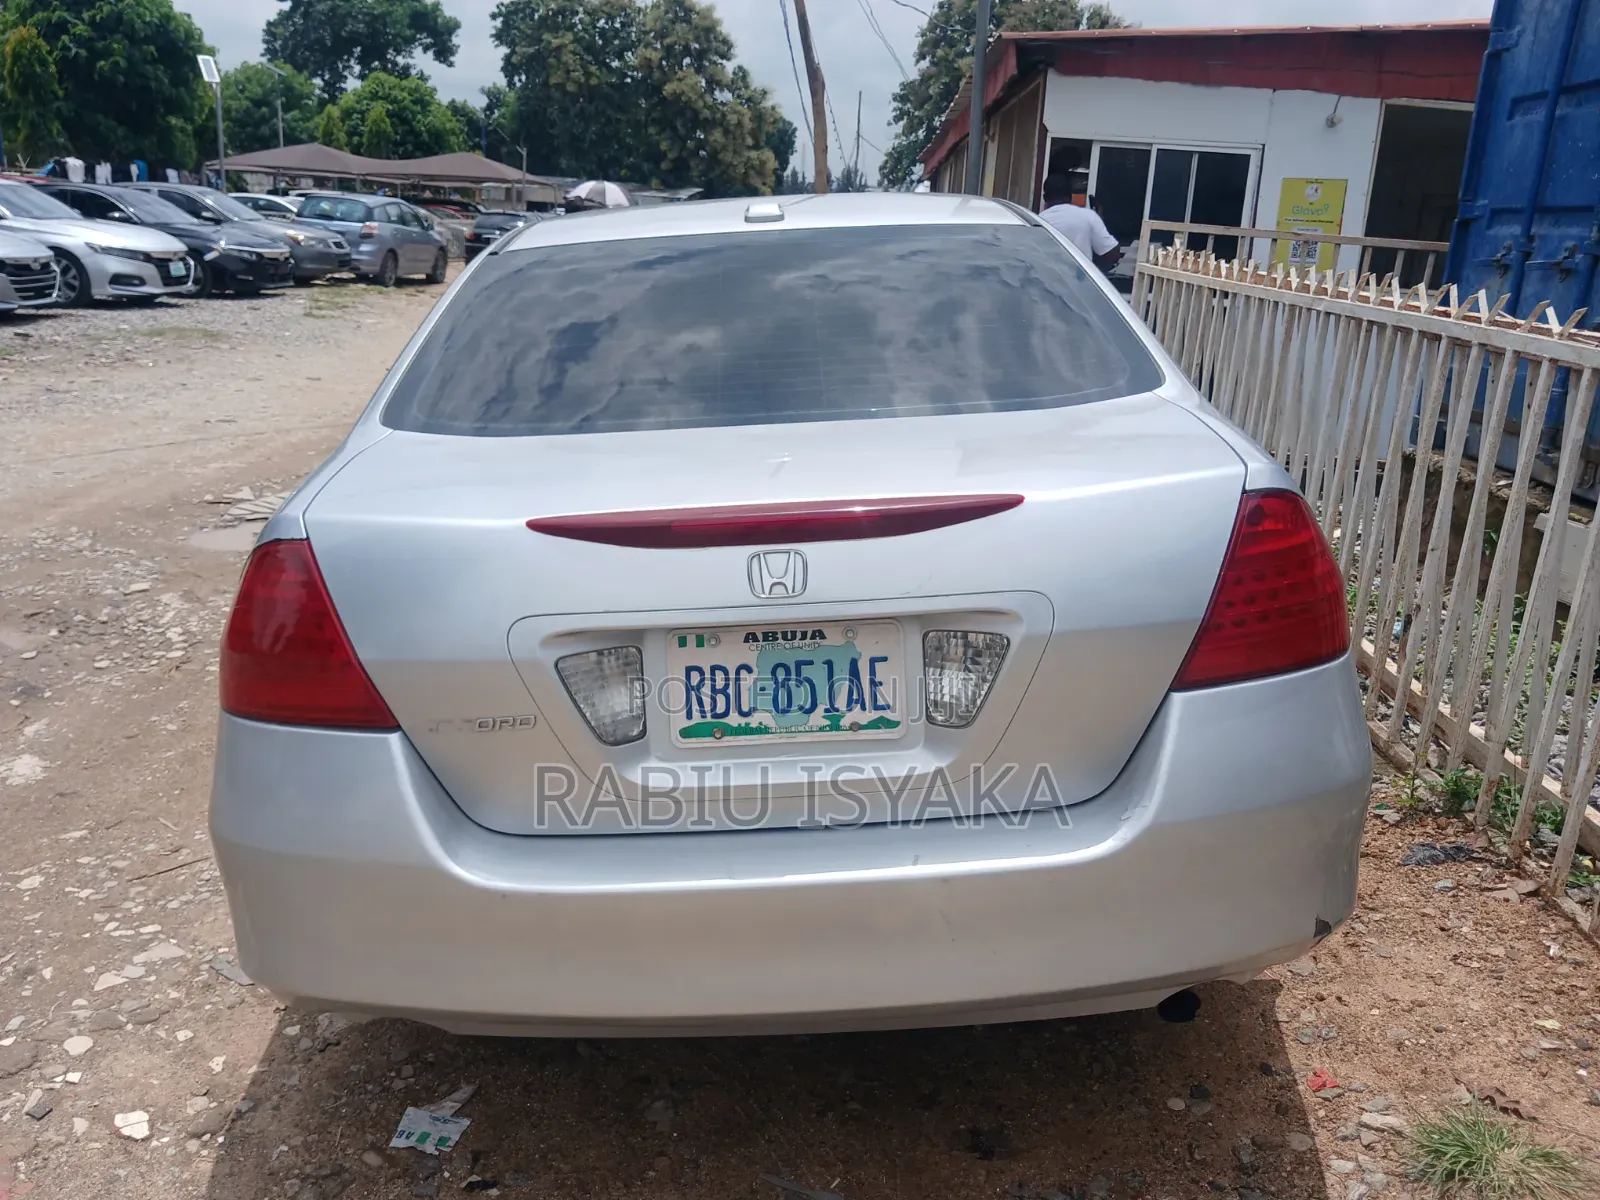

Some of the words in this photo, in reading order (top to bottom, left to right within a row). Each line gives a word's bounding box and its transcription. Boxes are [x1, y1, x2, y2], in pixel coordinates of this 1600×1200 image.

[743, 629, 827, 643] ABUJA
[748, 641, 782, 652] CENTRE
[783, 641, 795, 650] OF
[796, 640, 820, 650] UNITY
[684, 656, 891, 720] RBC-851AE
